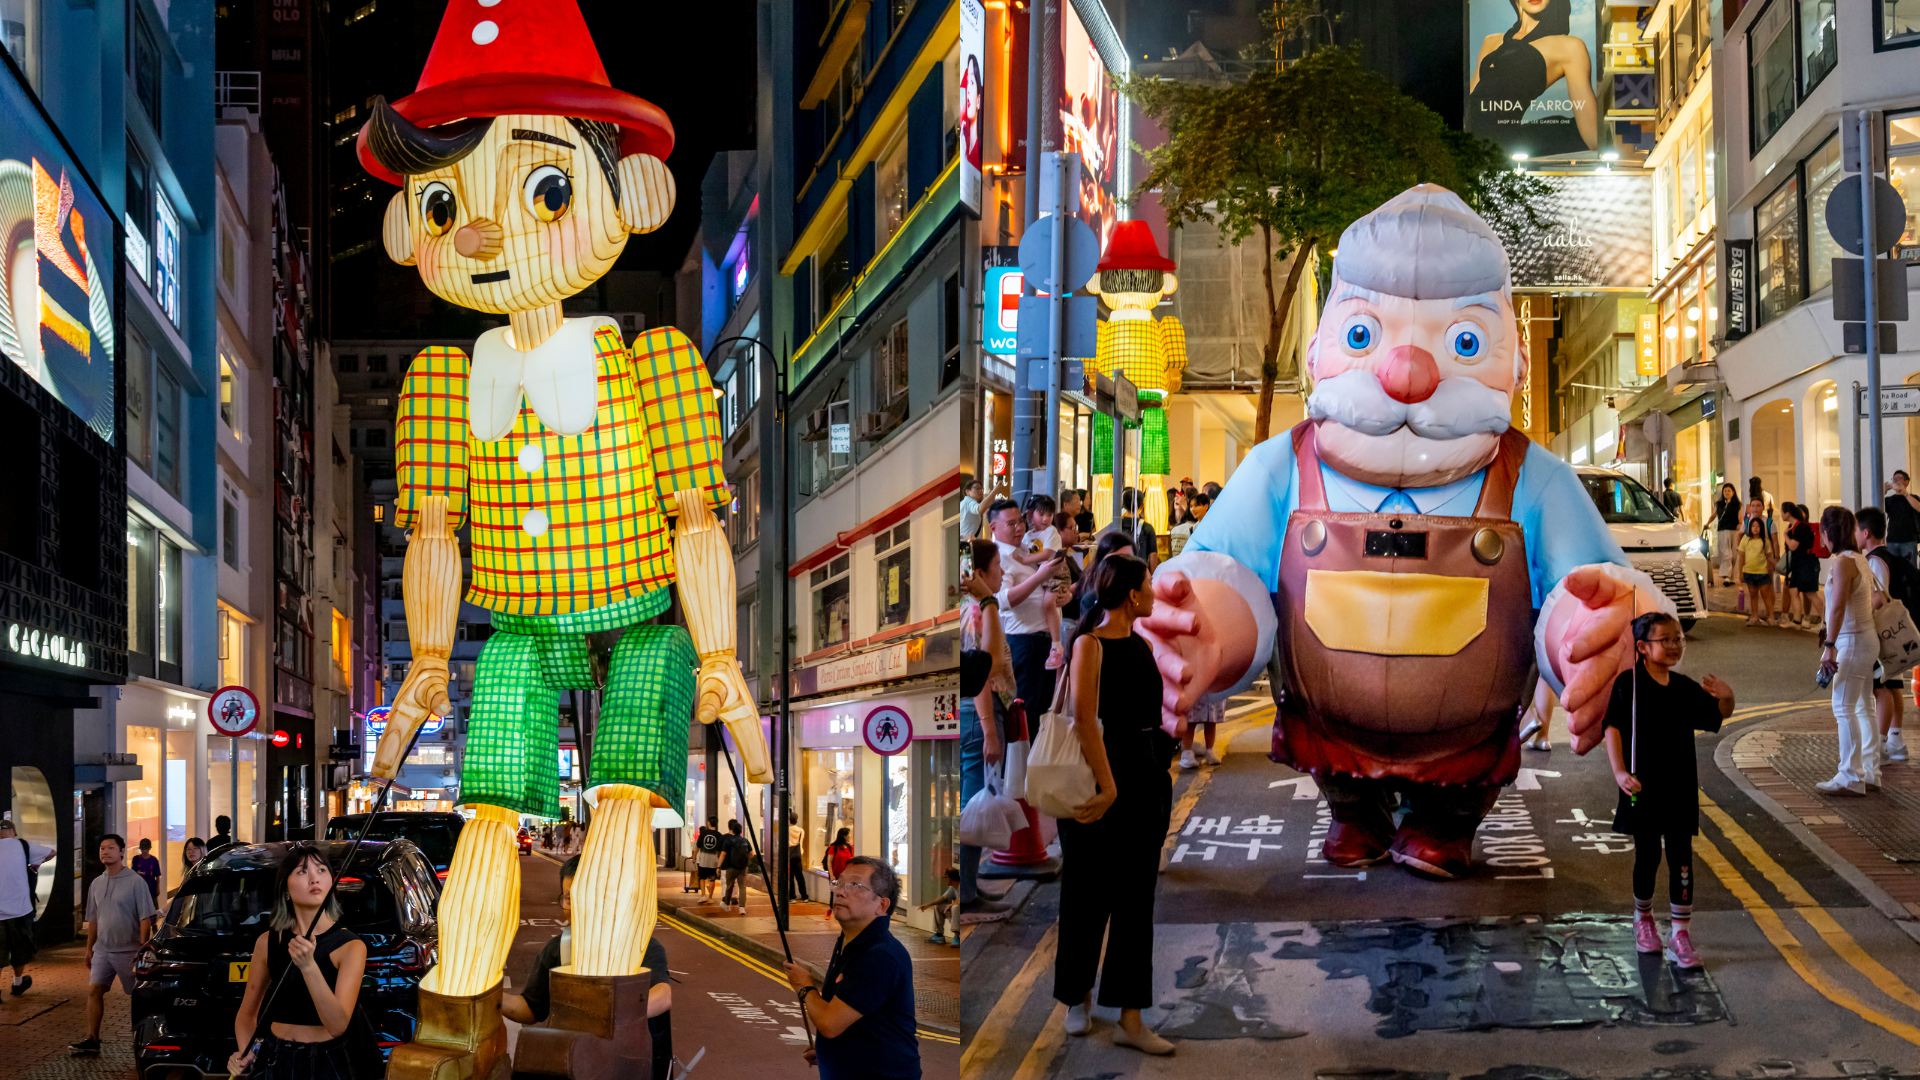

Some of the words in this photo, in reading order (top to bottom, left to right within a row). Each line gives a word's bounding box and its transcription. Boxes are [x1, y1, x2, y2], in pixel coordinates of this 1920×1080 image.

[272, 49, 301, 60] MUJI
[1480, 100, 1523, 111] LINDA
[1530, 100, 1586, 111] FARROW
[1543, 216, 1593, 247] aalis
[1731, 247, 1745, 331] BASEMENT
[1643, 320, 1653, 370] 日出金工
[820, 667, 833, 685] Paris
[833, 665, 851, 684] Cotton
[851, 655, 874, 682] Singlets
[1478, 833, 1555, 879] LOOK
